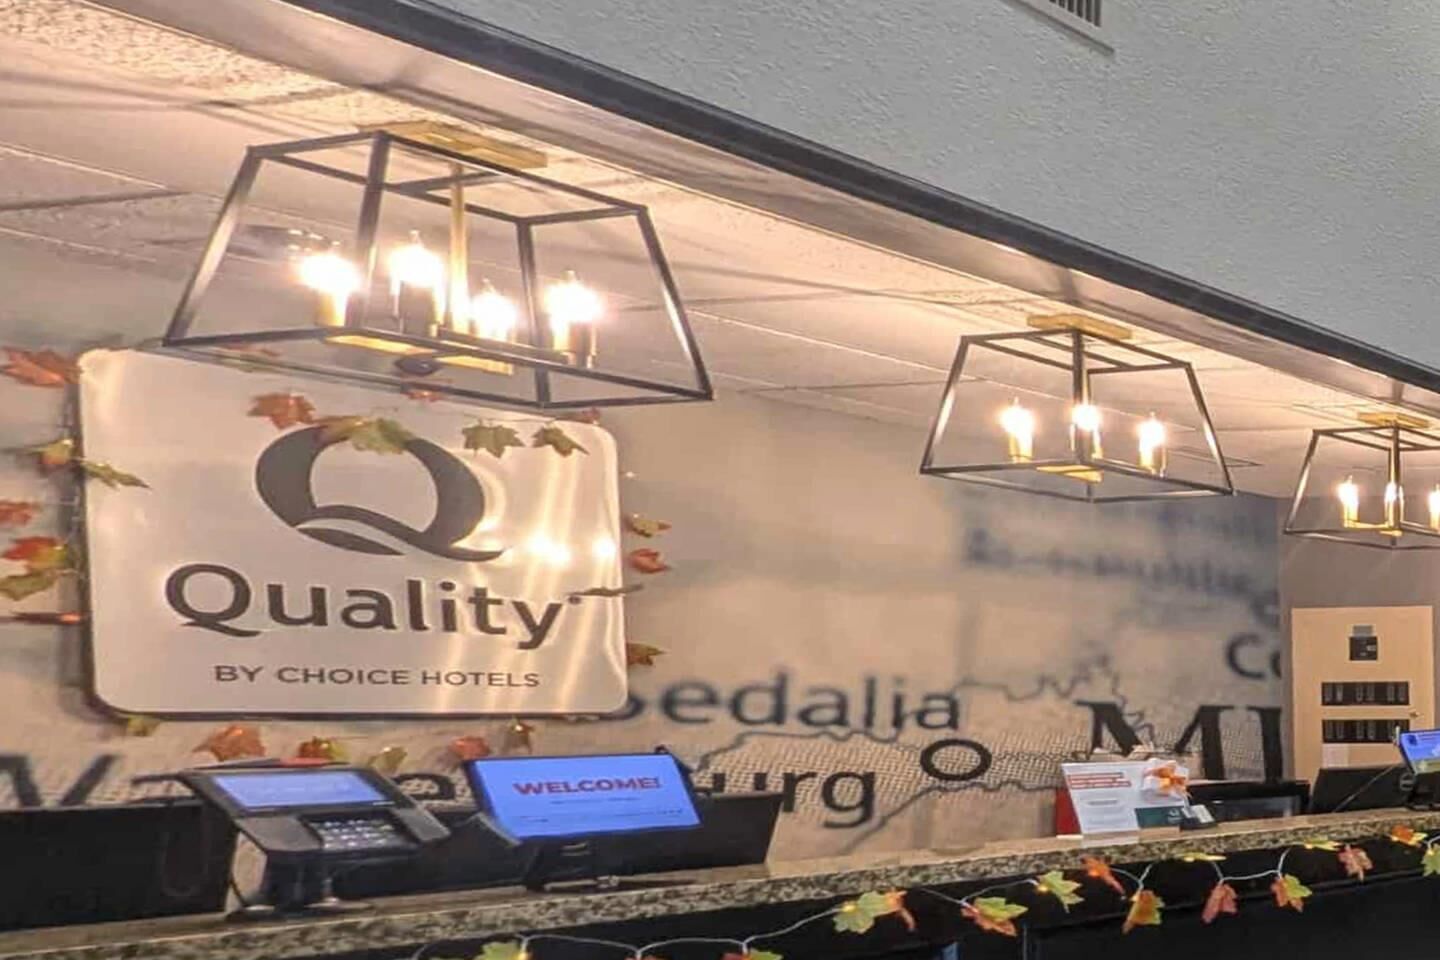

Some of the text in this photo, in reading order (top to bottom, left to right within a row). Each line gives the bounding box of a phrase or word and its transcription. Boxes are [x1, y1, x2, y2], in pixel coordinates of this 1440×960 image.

[165, 562, 563, 650] Quality
[213, 665, 541, 688] BY CHOICE HOTELS
[597, 670, 960, 732] edalia
[512, 776, 661, 796] WELCOME!
